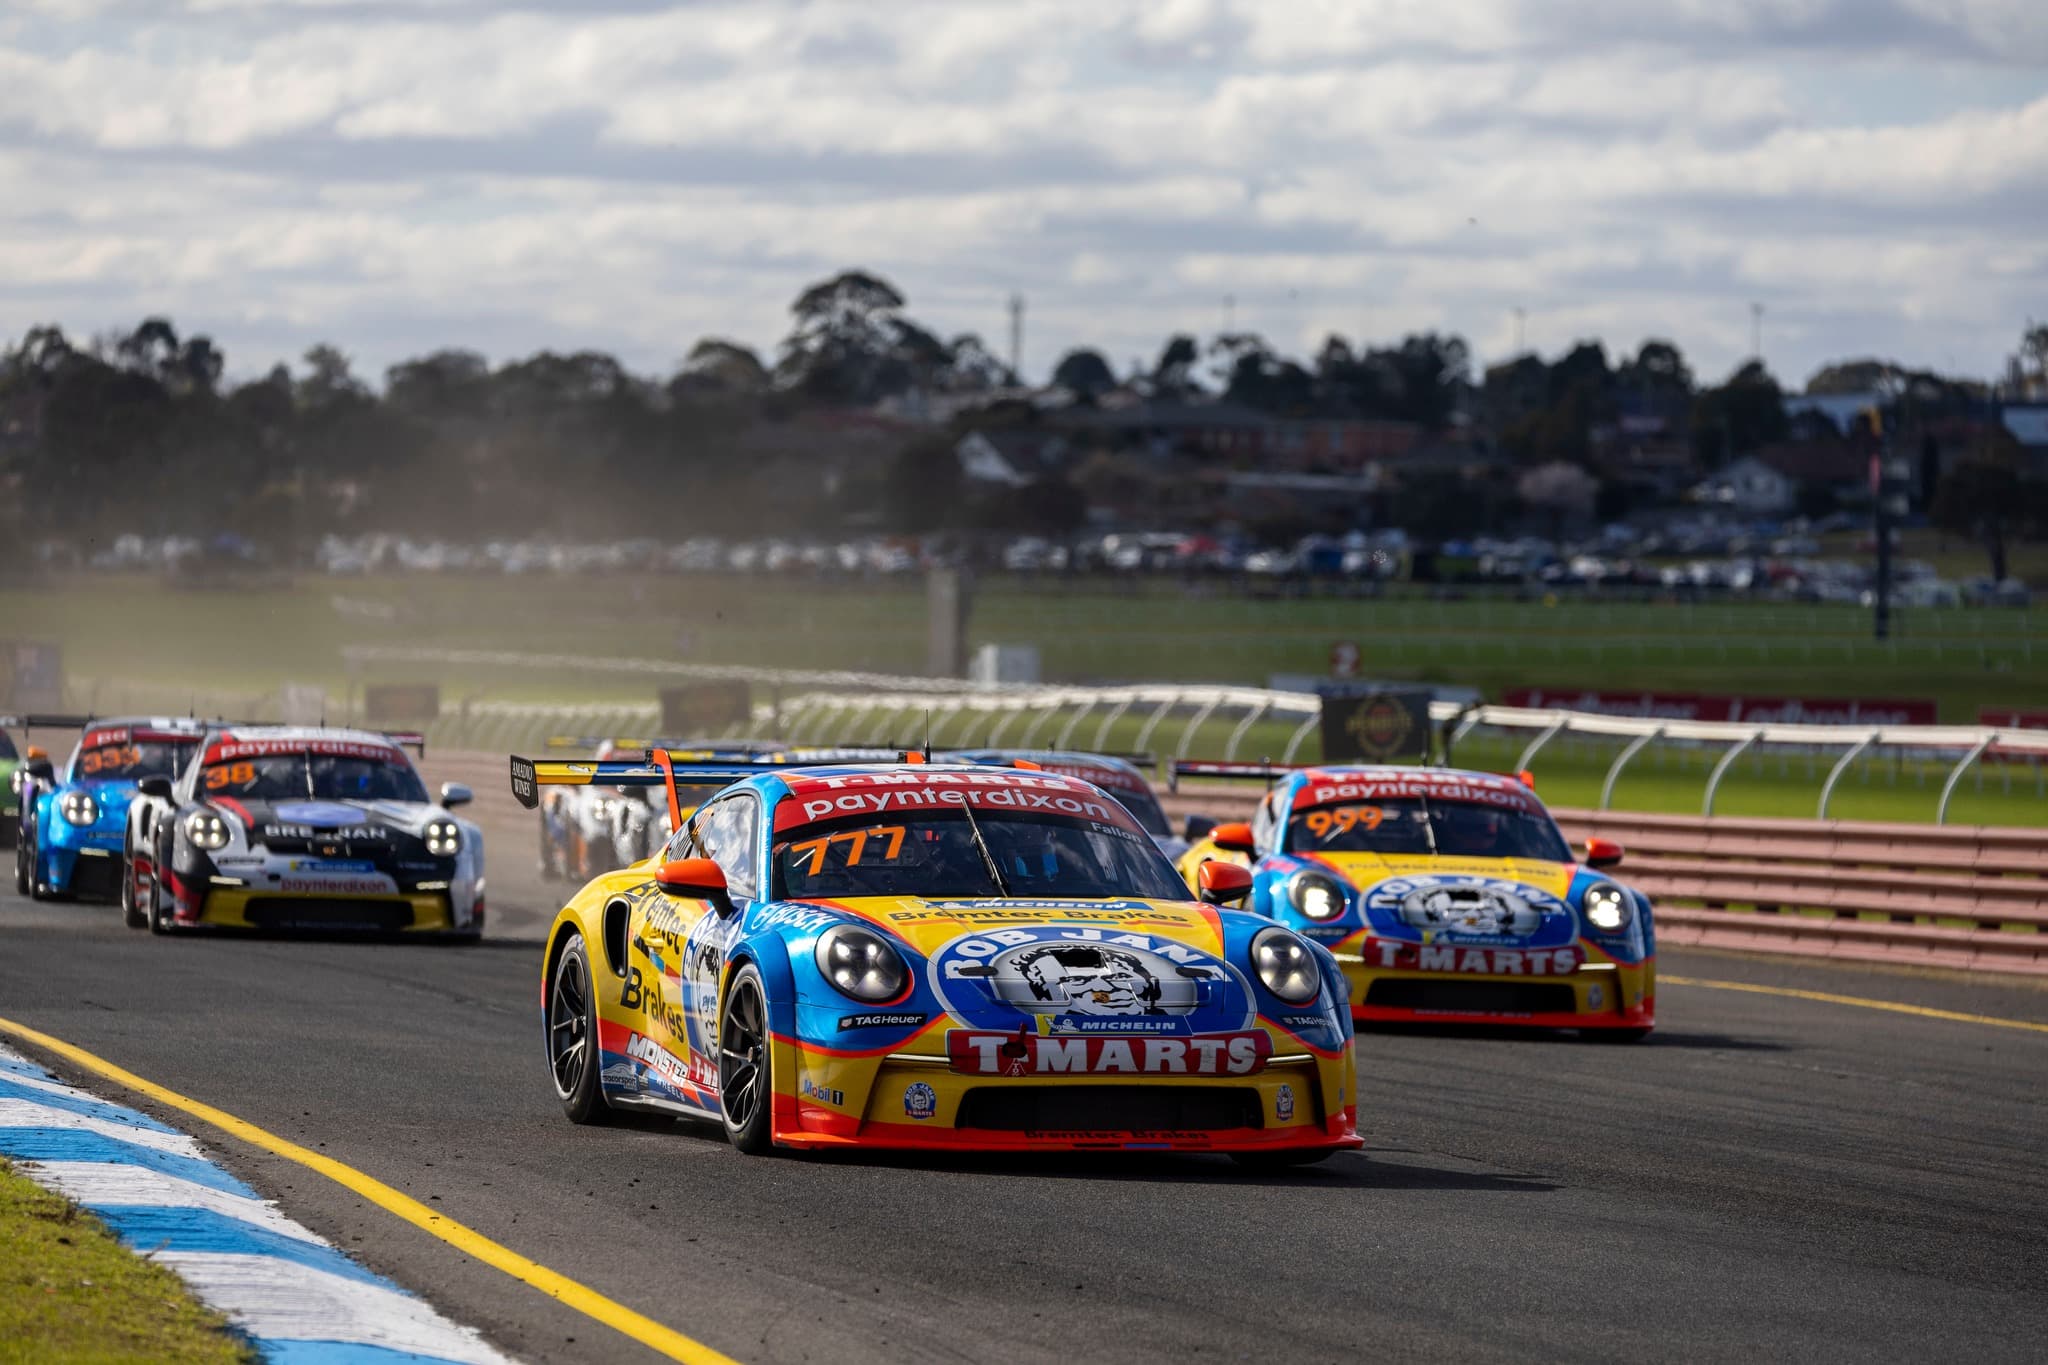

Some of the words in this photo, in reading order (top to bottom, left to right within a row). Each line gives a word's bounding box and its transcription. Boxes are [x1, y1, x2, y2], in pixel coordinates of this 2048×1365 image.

[220, 741, 393, 760] paynterdixon
[206, 761, 255, 790] 38
[512, 761, 533, 779] AMADIO
[514, 778, 531, 797] WINES
[1314, 779, 1527, 808] paynterdixon
[803, 787, 1112, 821] paynterdixon
[264, 825, 387, 840] BRENAN
[1091, 822, 1143, 844] Fallon
[1306, 804, 1384, 838] 999
[791, 826, 906, 876] 777
[764, 905, 840, 934] BOSCH
[889, 910, 1051, 921] Bremtec
[1064, 910, 1188, 922] Brakes
[975, 901, 1129, 910] MICHELIN
[944, 929, 1038, 980] BOB
[1376, 940, 1576, 975] TMARTS
[620, 966, 685, 1044] Brakes
[1081, 1021, 1176, 1031] MICHELIN
[625, 1032, 689, 1079] MONSTER
[968, 1036, 1257, 1074] TMARTS
[656, 1078, 686, 1102] WHEELS
[804, 1080, 830, 1102] Mobil
[833, 1091, 843, 1105] 1
